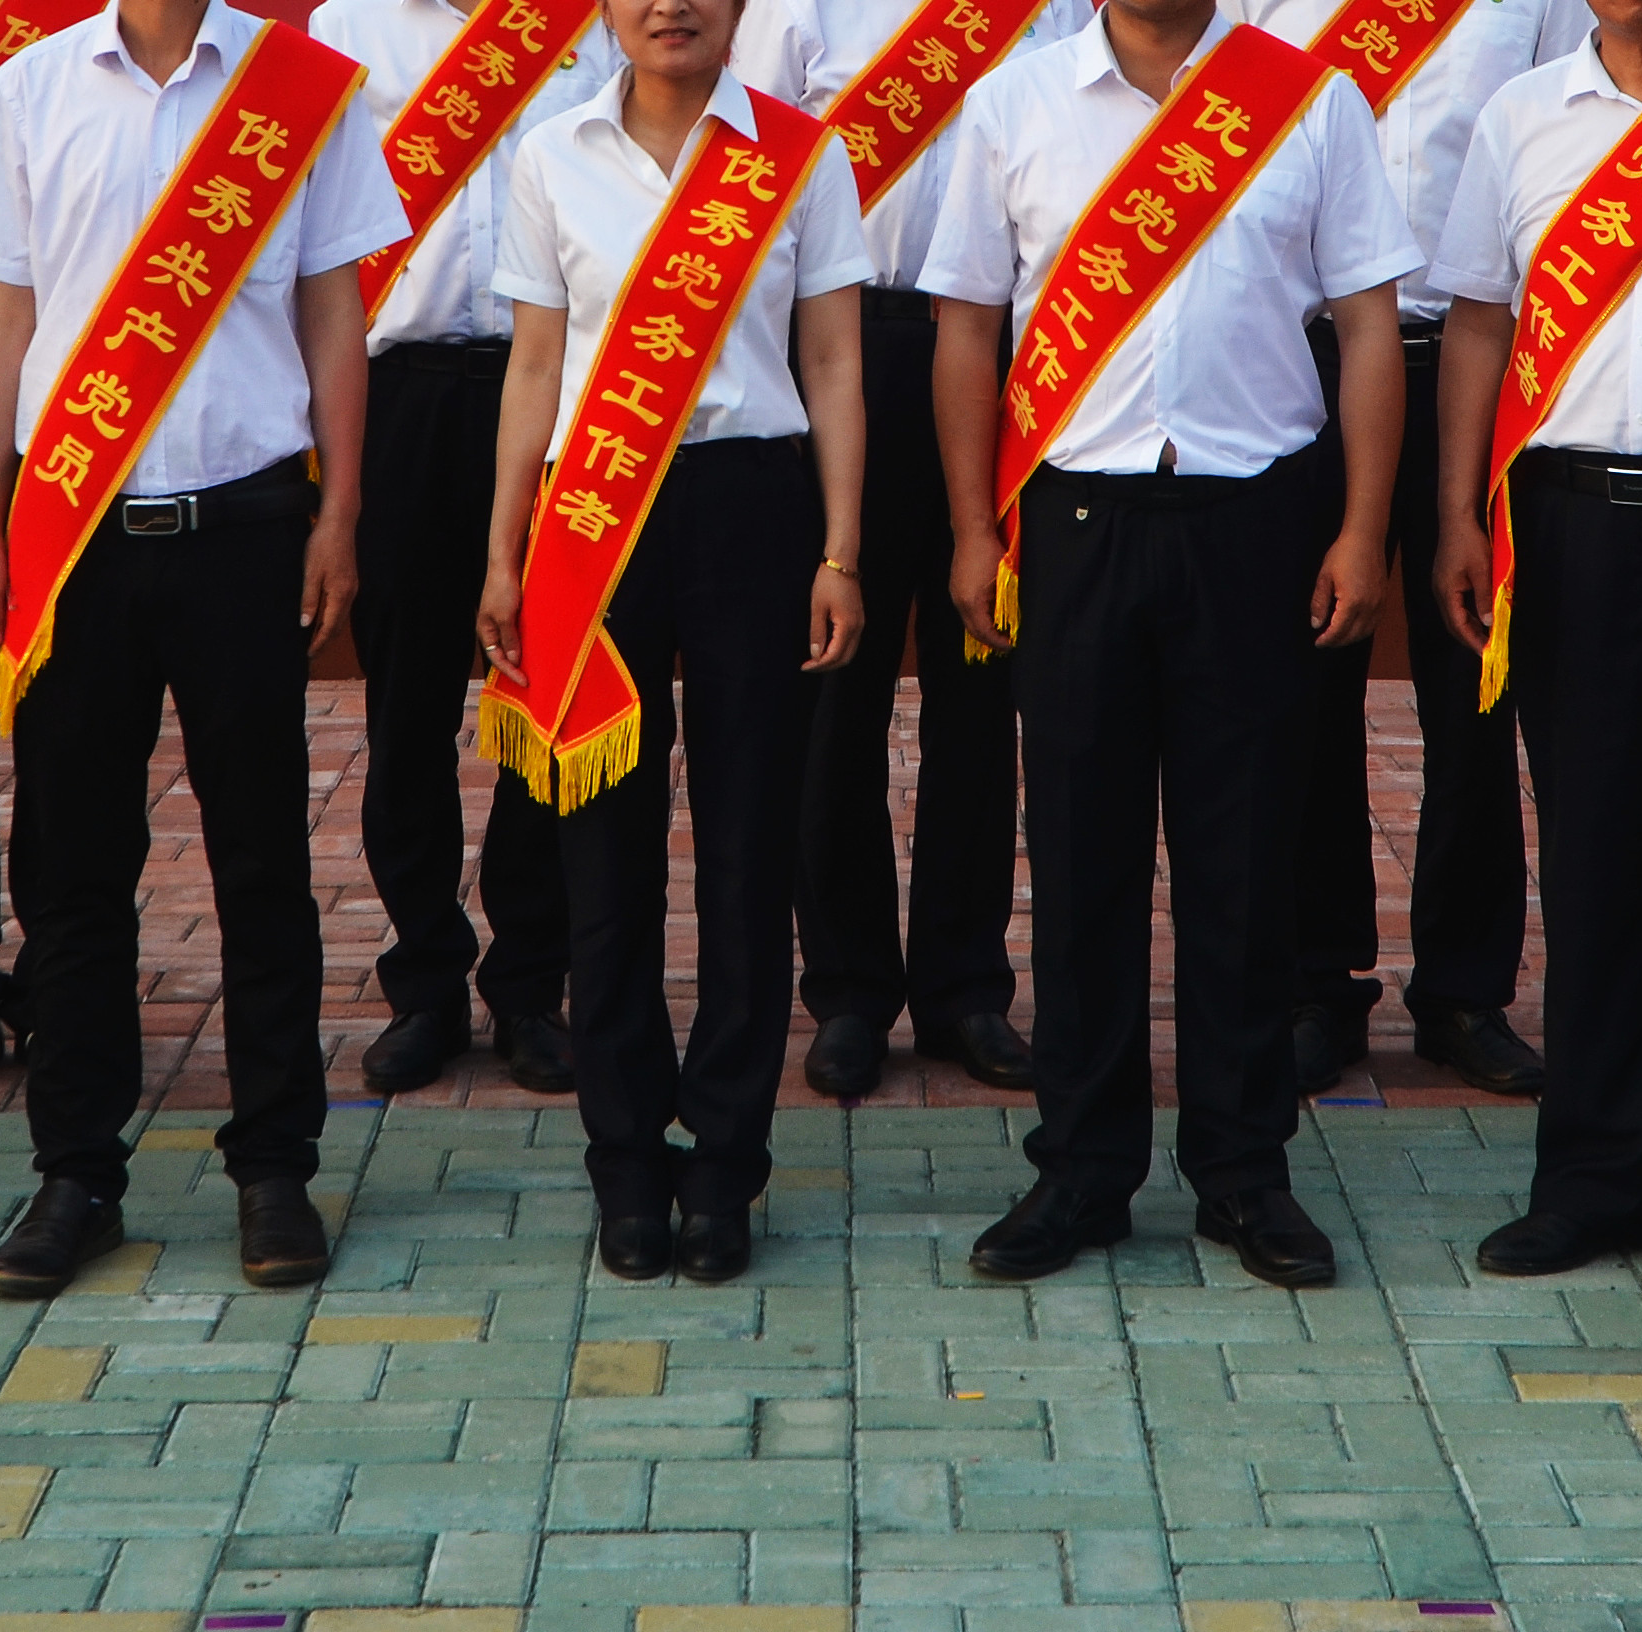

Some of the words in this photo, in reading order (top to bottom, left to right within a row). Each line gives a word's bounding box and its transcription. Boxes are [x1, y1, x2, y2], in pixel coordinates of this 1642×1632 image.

[34, 108, 287, 508] 优秀共产党员
[555, 145, 778, 544] 优秀党务工作者
[1009, 89, 1253, 441] 优秀党务工作者
